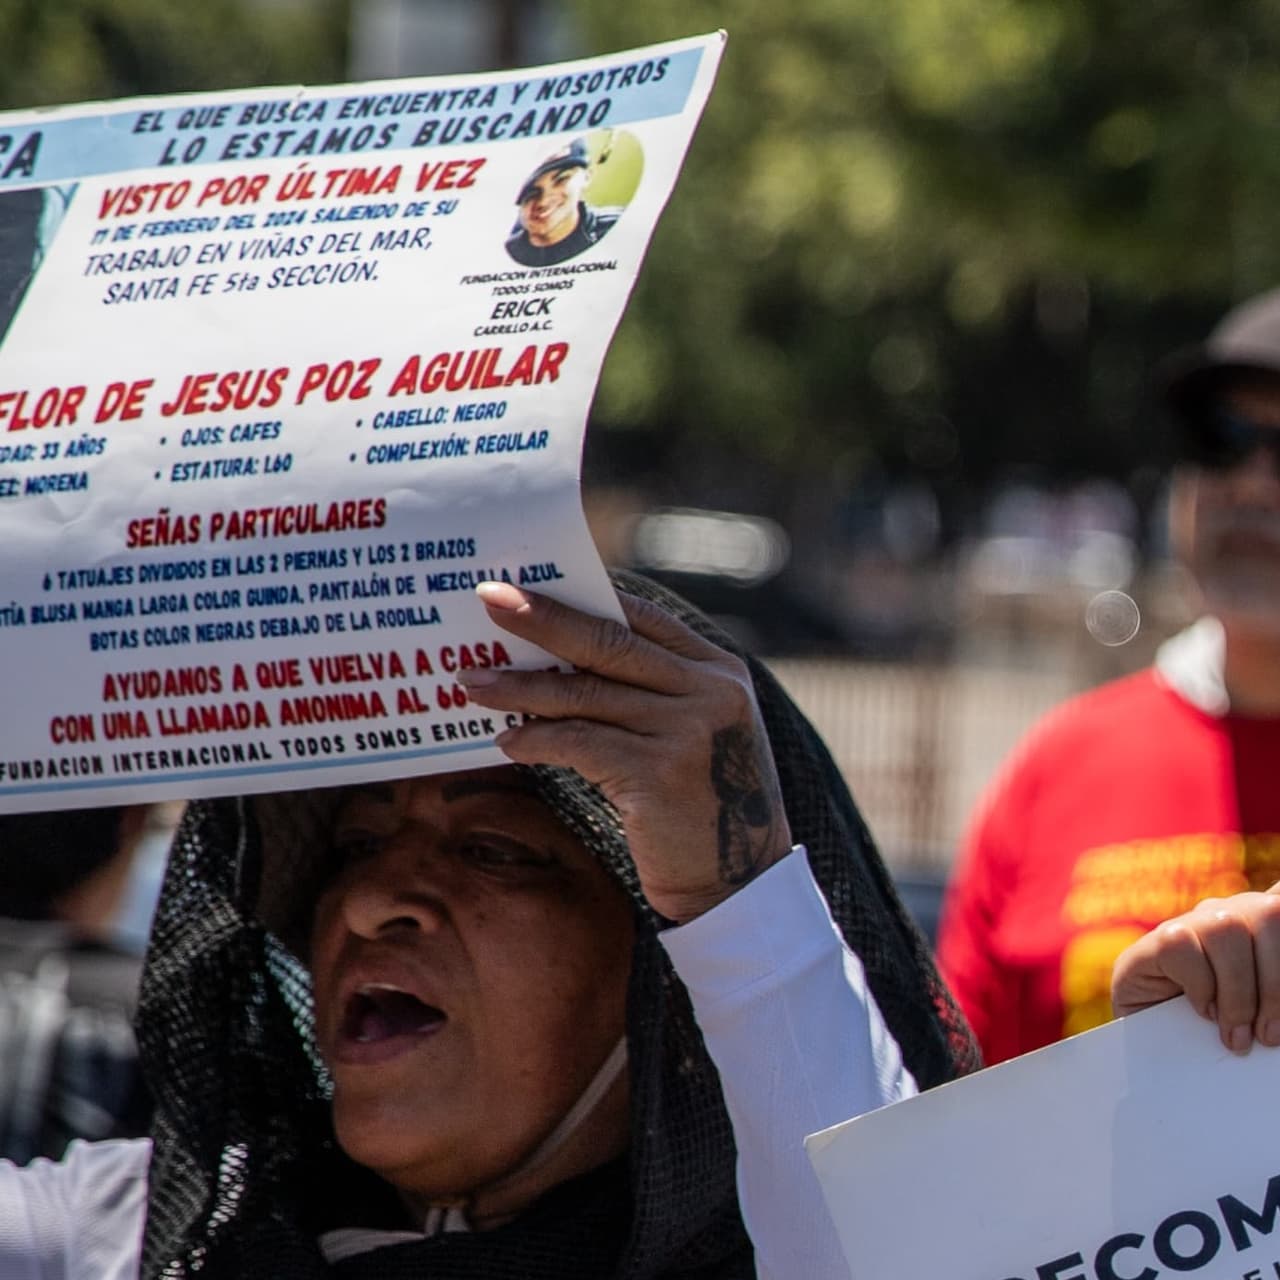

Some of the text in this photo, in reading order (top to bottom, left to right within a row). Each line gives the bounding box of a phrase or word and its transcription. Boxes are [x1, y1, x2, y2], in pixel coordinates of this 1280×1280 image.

[131, 58, 671, 134] EL QUE BUSCA ENCUENTRA Y NOSOTROS
[158, 96, 612, 165] LO ESTAMOS BUSCANDO
[97, 156, 487, 220] VISTO POR ÚLTIMA VEZ
[83, 226, 432, 276] TRABAJO EN VIÑAS DEL MAR,
[137, 215, 221, 238] FEBRERO
[101, 276, 180, 305] SANTA
[185, 272, 219, 296] FE
[265, 257, 378, 289] SECCIÓN.
[489, 296, 556, 320] ERICK
[0, 341, 569, 432] FLOR DE JESUS POZ AGUILAR
[125, 497, 387, 549] SEÑAS PARTICULARES
